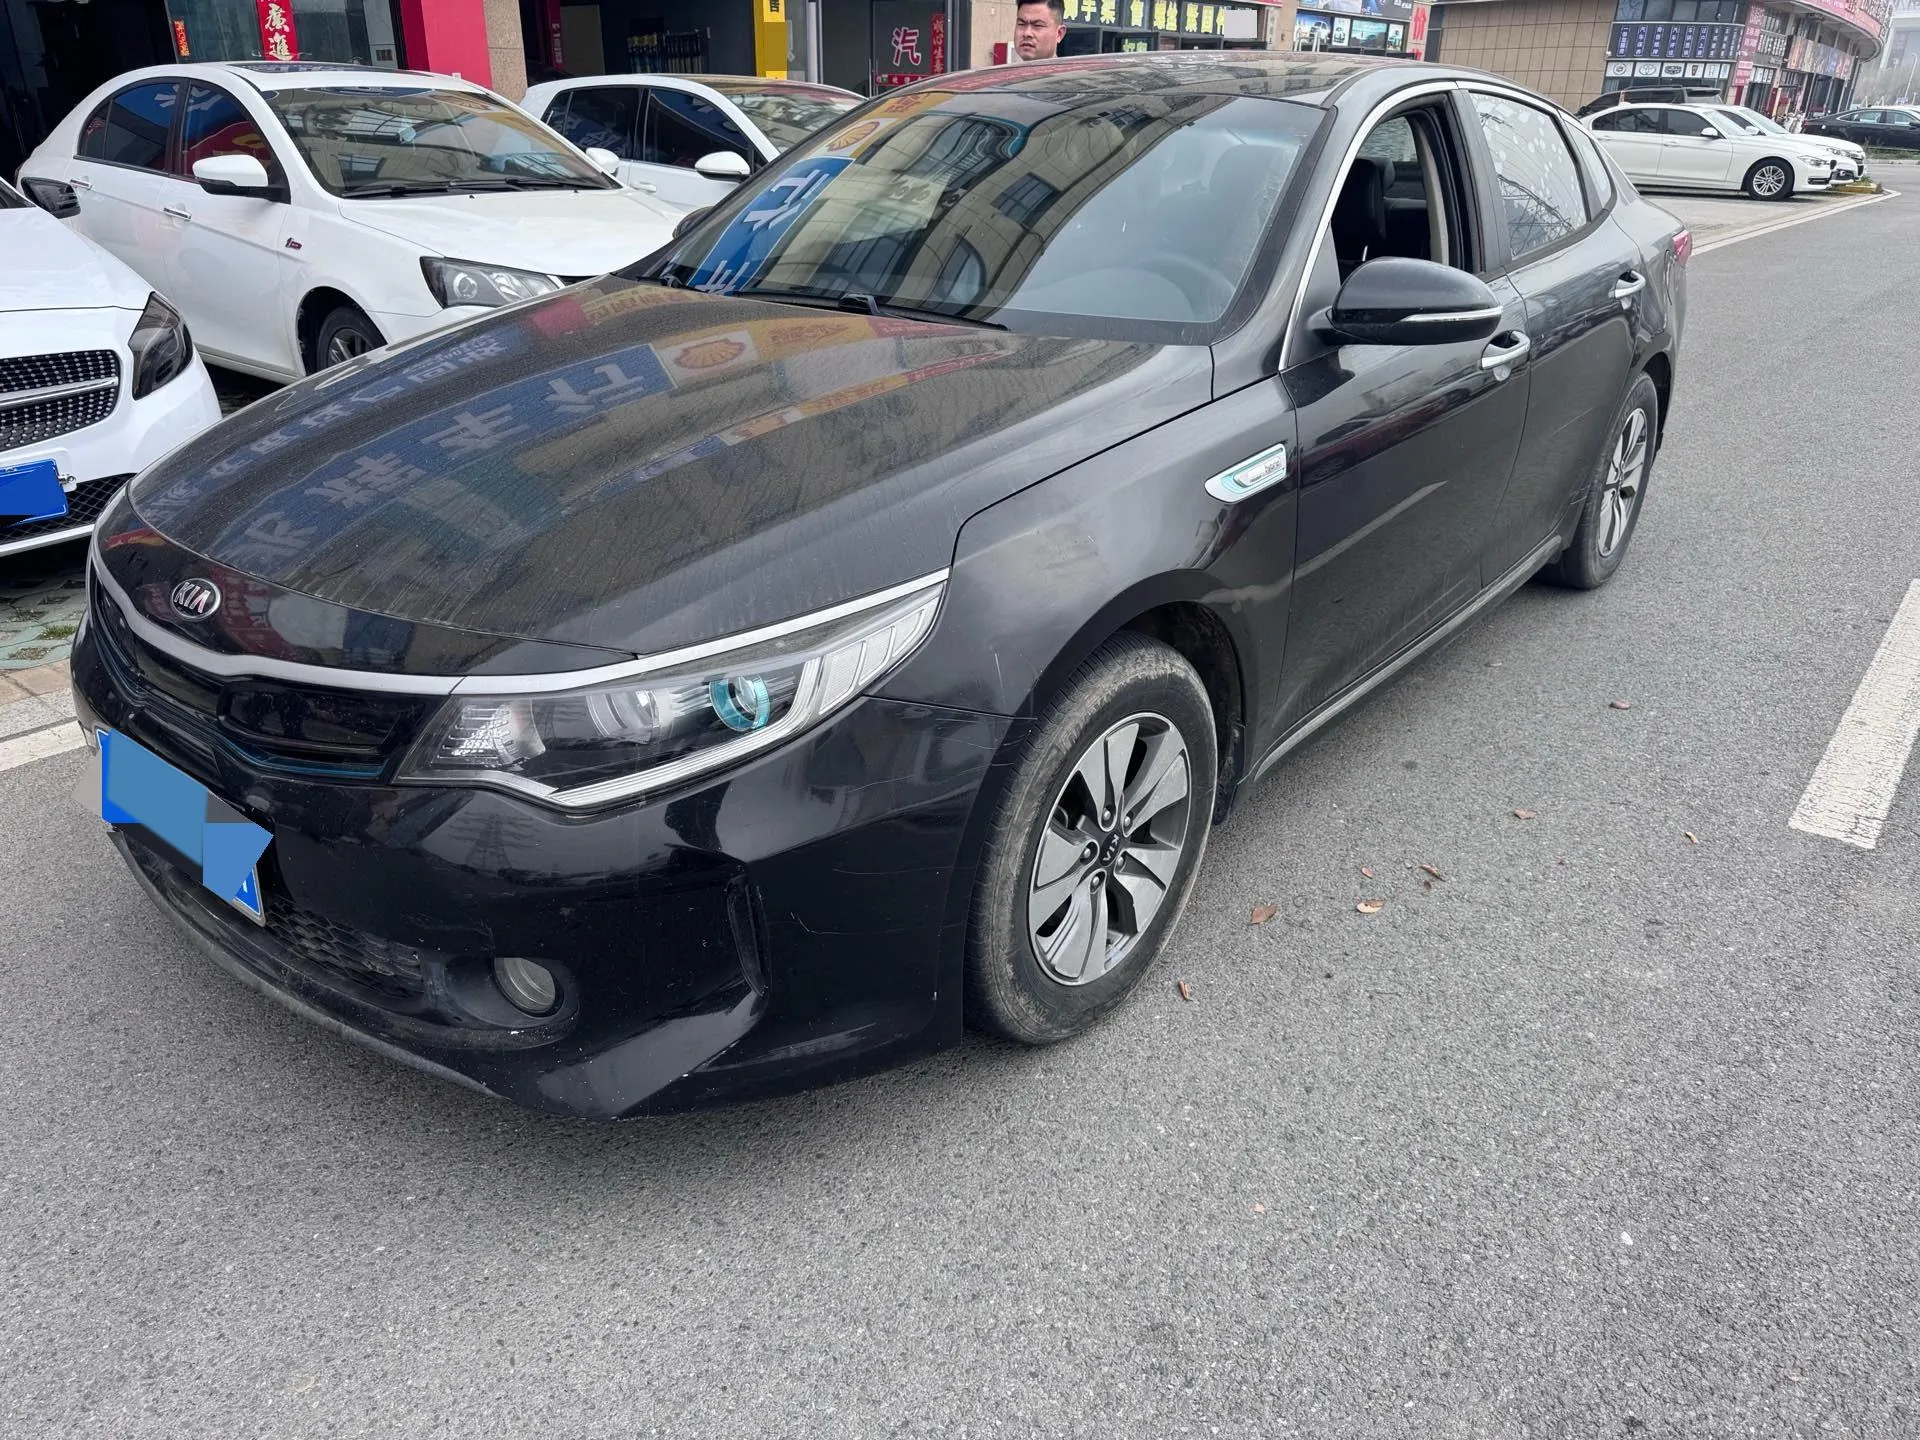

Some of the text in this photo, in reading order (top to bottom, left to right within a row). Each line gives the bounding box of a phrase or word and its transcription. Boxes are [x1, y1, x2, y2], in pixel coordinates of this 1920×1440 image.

[891, 26, 922, 67] 汽
[173, 581, 211, 614] KIA
[1102, 833, 1120, 861] KIA
